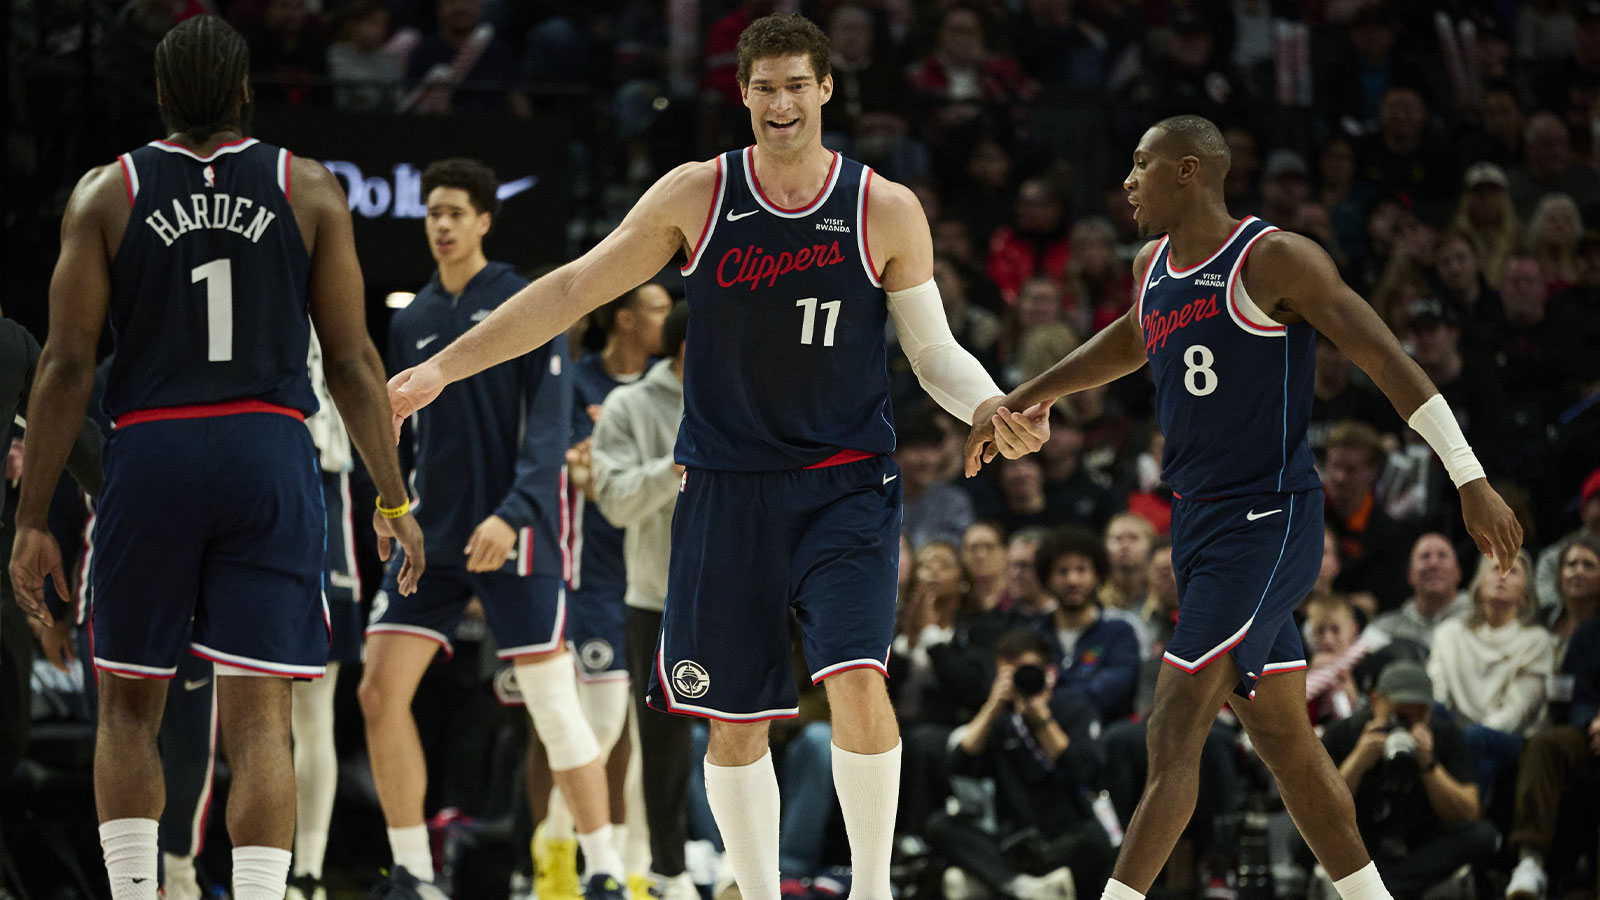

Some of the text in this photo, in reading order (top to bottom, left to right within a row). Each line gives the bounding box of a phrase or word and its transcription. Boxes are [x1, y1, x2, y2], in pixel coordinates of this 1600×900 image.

[145, 193, 276, 247] HARDEN
[815, 223, 850, 233] RWANDA
[823, 218, 844, 226] VISIT
[716, 240, 846, 291] Clippers
[1194, 279, 1225, 287] RWANDA
[1202, 273, 1221, 281] VISIT
[191, 258, 233, 362] 1
[796, 297, 842, 347] 11
[1183, 344, 1218, 397] 8
